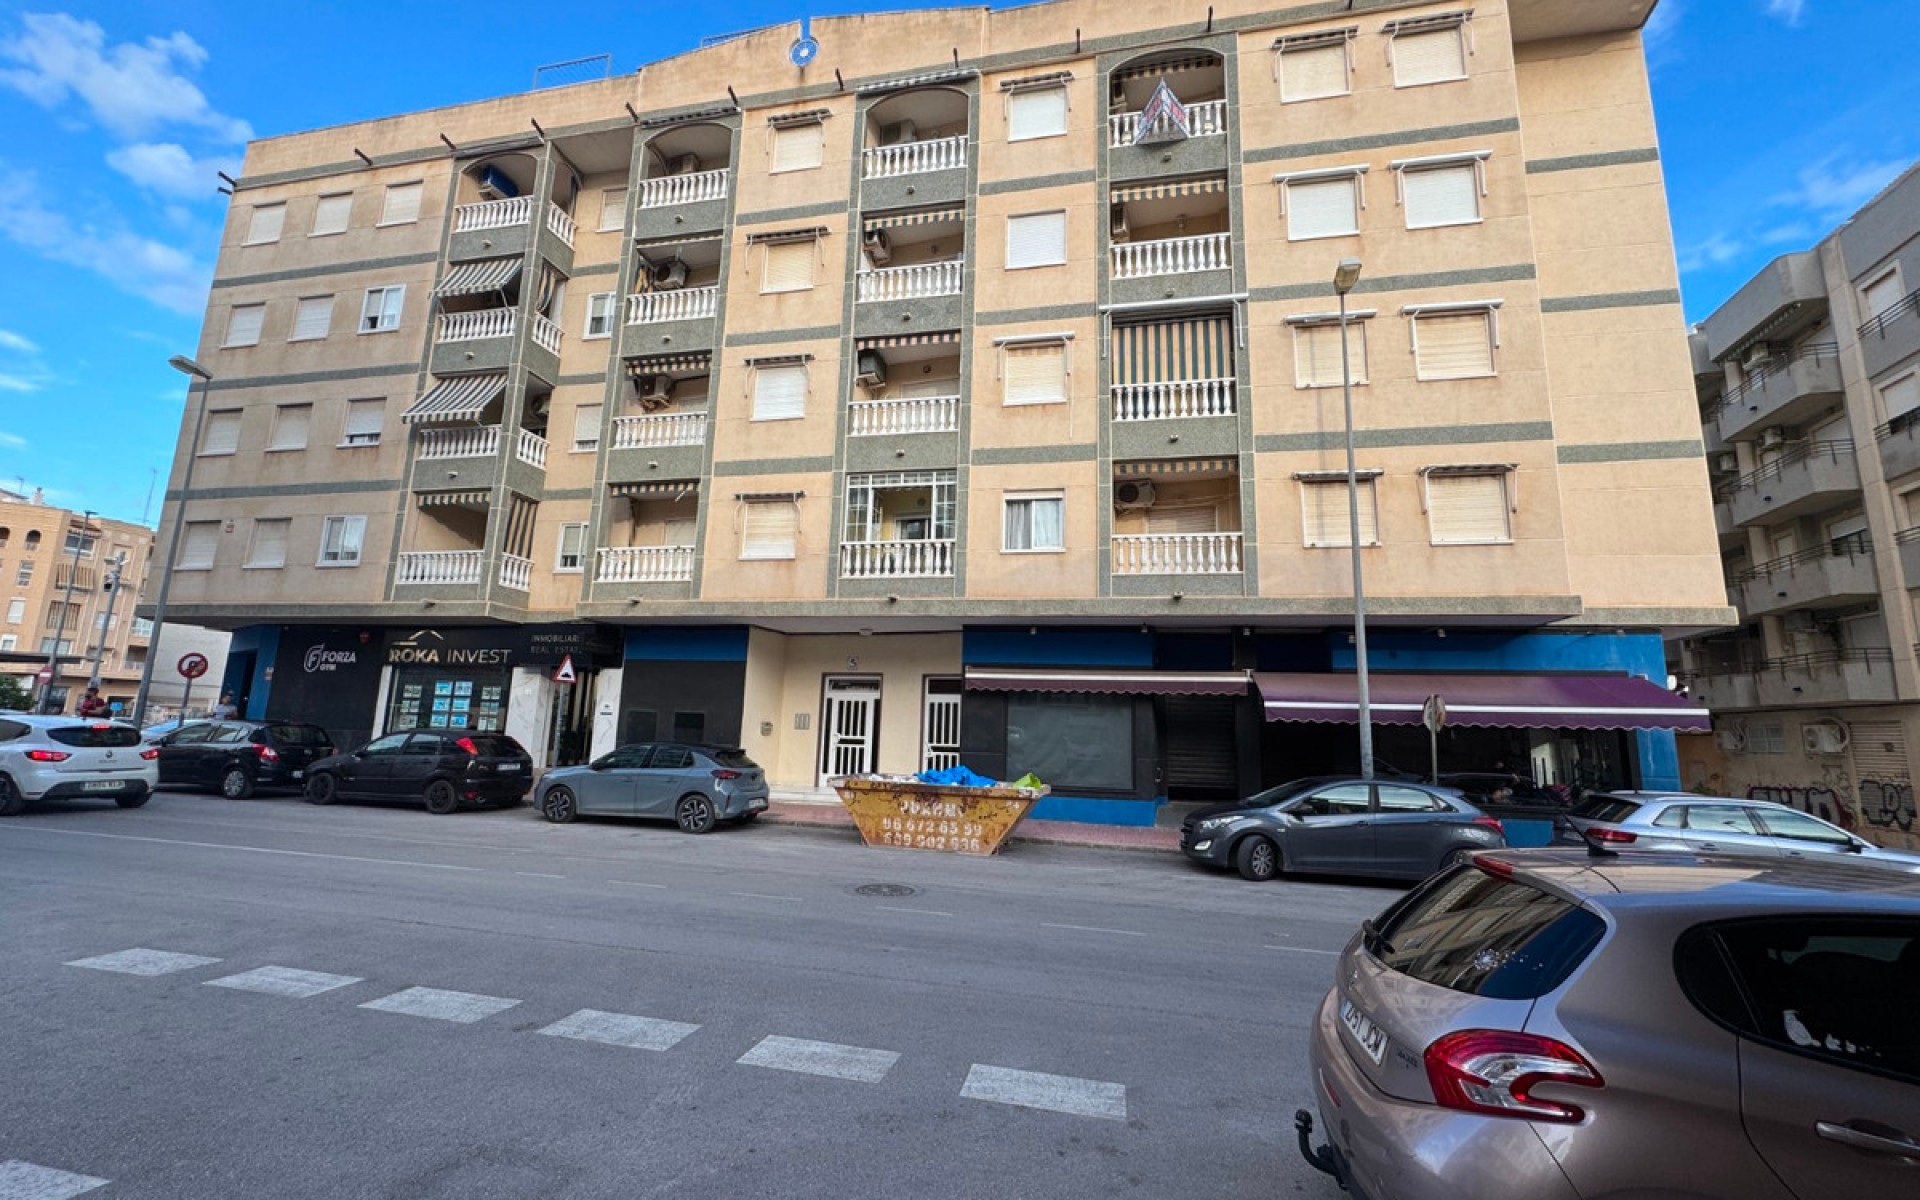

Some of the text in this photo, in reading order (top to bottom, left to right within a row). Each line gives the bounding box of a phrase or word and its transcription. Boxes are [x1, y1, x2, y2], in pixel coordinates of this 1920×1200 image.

[321, 650, 356, 663] FORZA
[389, 648, 512, 663] ROKA INVEST
